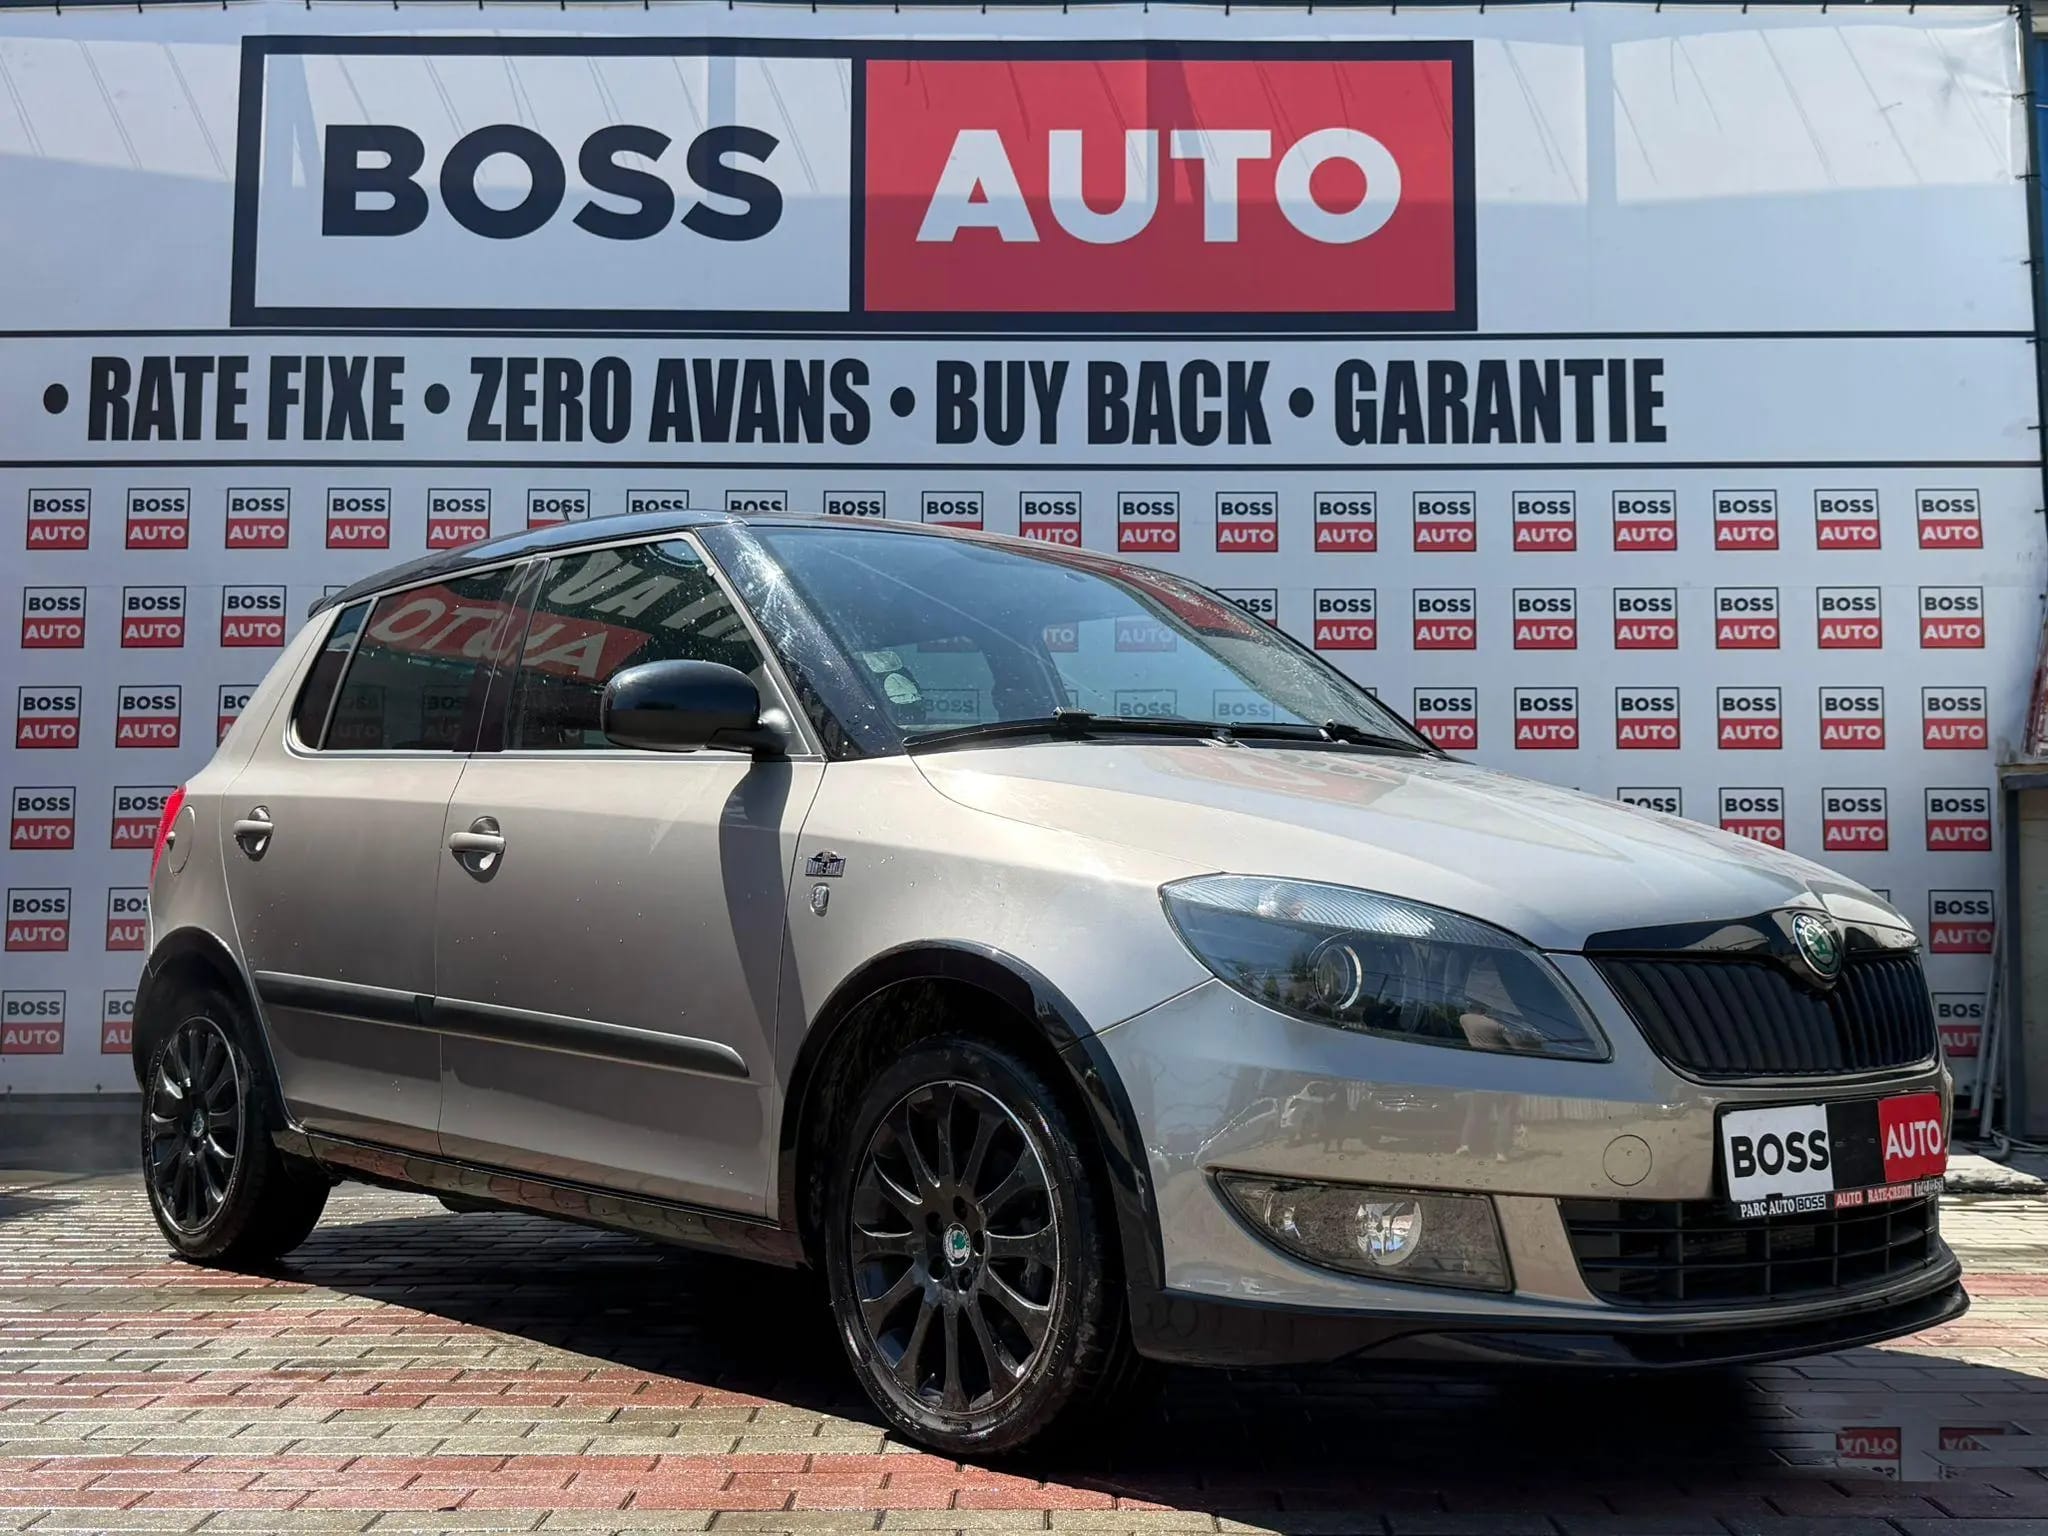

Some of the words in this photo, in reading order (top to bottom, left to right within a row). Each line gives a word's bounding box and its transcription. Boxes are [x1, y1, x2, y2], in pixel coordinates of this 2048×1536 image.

[321, 124, 783, 241] BOSS
[916, 127, 1402, 245] AUTO
[88, 356, 248, 441] RATE
[268, 356, 404, 441] FIXE
[468, 357, 631, 443] ZERO
[649, 358, 870, 445] AVANS
[936, 360, 1069, 446] BUY
[1088, 359, 1271, 446] BACK
[1335, 359, 1666, 446] GARANTIE
[34, 499, 85, 512] BOSS
[133, 499, 184, 512] BOSS
[232, 498, 284, 511] BOSS
[333, 498, 385, 512] BOSS
[433, 499, 486, 512] BOSS
[533, 499, 585, 512] BOSS
[829, 501, 881, 515] BOSS
[927, 501, 979, 515] BOSS
[1025, 502, 1076, 515] BOSS
[1123, 502, 1174, 515] BOSS
[1222, 502, 1272, 515] BOSS
[1320, 502, 1371, 515] BOSS
[1419, 502, 1470, 515] BOSS
[1518, 501, 1570, 514] BOSS
[1619, 500, 1671, 514] BOSS
[1719, 500, 1772, 513] BOSS
[1821, 500, 1873, 512] BOSS
[1922, 499, 1975, 512] BOSS
[30, 526, 85, 540] AUTO
[130, 526, 185, 539] AUTO
[229, 525, 285, 539] AUTO
[330, 526, 386, 539] AUTO
[431, 526, 486, 539] AUTO
[1121, 529, 1176, 542] AUTO
[1220, 529, 1274, 543] AUTO
[1318, 529, 1373, 542] AUTO
[1417, 529, 1473, 542] AUTO
[1517, 528, 1573, 542] AUTO
[1617, 528, 1673, 541] AUTO
[1718, 527, 1775, 541] AUTO
[1820, 526, 1877, 540] AUTO
[1922, 526, 1978, 540] AUTO
[29, 597, 80, 611] BOSS
[128, 597, 180, 610] BOSS
[228, 596, 280, 609] BOSS
[1320, 599, 1371, 612] BOSS
[1419, 599, 1470, 612] BOSS
[1519, 599, 1571, 612] BOSS
[1620, 598, 1672, 611] BOSS
[1721, 598, 1773, 611] BOSS
[1823, 597, 1876, 611] BOSS
[1925, 597, 1978, 610] BOSS
[25, 625, 81, 639] AUTO
[125, 624, 181, 638] AUTO
[225, 623, 281, 637] AUTO
[1318, 627, 1373, 640] AUTO
[1417, 626, 1473, 640] AUTO
[1517, 626, 1573, 640] AUTO
[1618, 626, 1674, 640] AUTO
[1719, 626, 1776, 639] AUTO
[1822, 625, 1878, 639] AUTO
[1924, 624, 1981, 638] AUTO
[24, 697, 75, 710] BOSS
[123, 696, 176, 710] BOSS
[224, 695, 250, 709] BO
[1218, 701, 1271, 716] BOSS
[1420, 698, 1472, 711] BOSS
[1520, 698, 1573, 711] BOSS
[1622, 698, 1674, 711] BOSS
[1723, 698, 1776, 711] BOSS
[1826, 698, 1879, 711] BOSS
[1928, 698, 1981, 711] BOSS
[20, 725, 76, 739] AUTO
[120, 724, 176, 738] AUTO
[1518, 726, 1575, 739] AUTO
[1620, 726, 1676, 739] AUTO
[1721, 726, 1779, 739] AUTO
[1824, 726, 1881, 739] AUTO
[1927, 726, 1983, 739] AUTO
[18, 797, 70, 811] BOSS
[1726, 798, 1778, 812] BOSS
[1828, 799, 1882, 812] BOSS
[1931, 799, 1985, 813] BOSS
[14, 825, 71, 840] AUTO
[115, 825, 157, 839] AUT
[1827, 827, 1884, 841] AUTO
[1930, 827, 1987, 841] AUTO
[13, 899, 65, 913] BOSS
[1935, 901, 1989, 914] BOSS
[9, 927, 65, 941] AUTO
[1933, 929, 1991, 943] AUTO
[7, 1001, 60, 1015] BOSS
[108, 1001, 134, 1014] BO
[1939, 1004, 1984, 1018] BOS
[4, 1030, 60, 1044] AUTO
[105, 1030, 132, 1044] AU
[1941, 1032, 1981, 1046] AUT
[1731, 1129, 1829, 1178] BOSS
[1885, 1119, 1941, 1160] AUTO
[1740, 1203, 1768, 1218] PARC
[1769, 1199, 1796, 1215] AUTO
[1797, 1196, 1825, 1211] BOSS
[1837, 1191, 1863, 1206] AUTO
